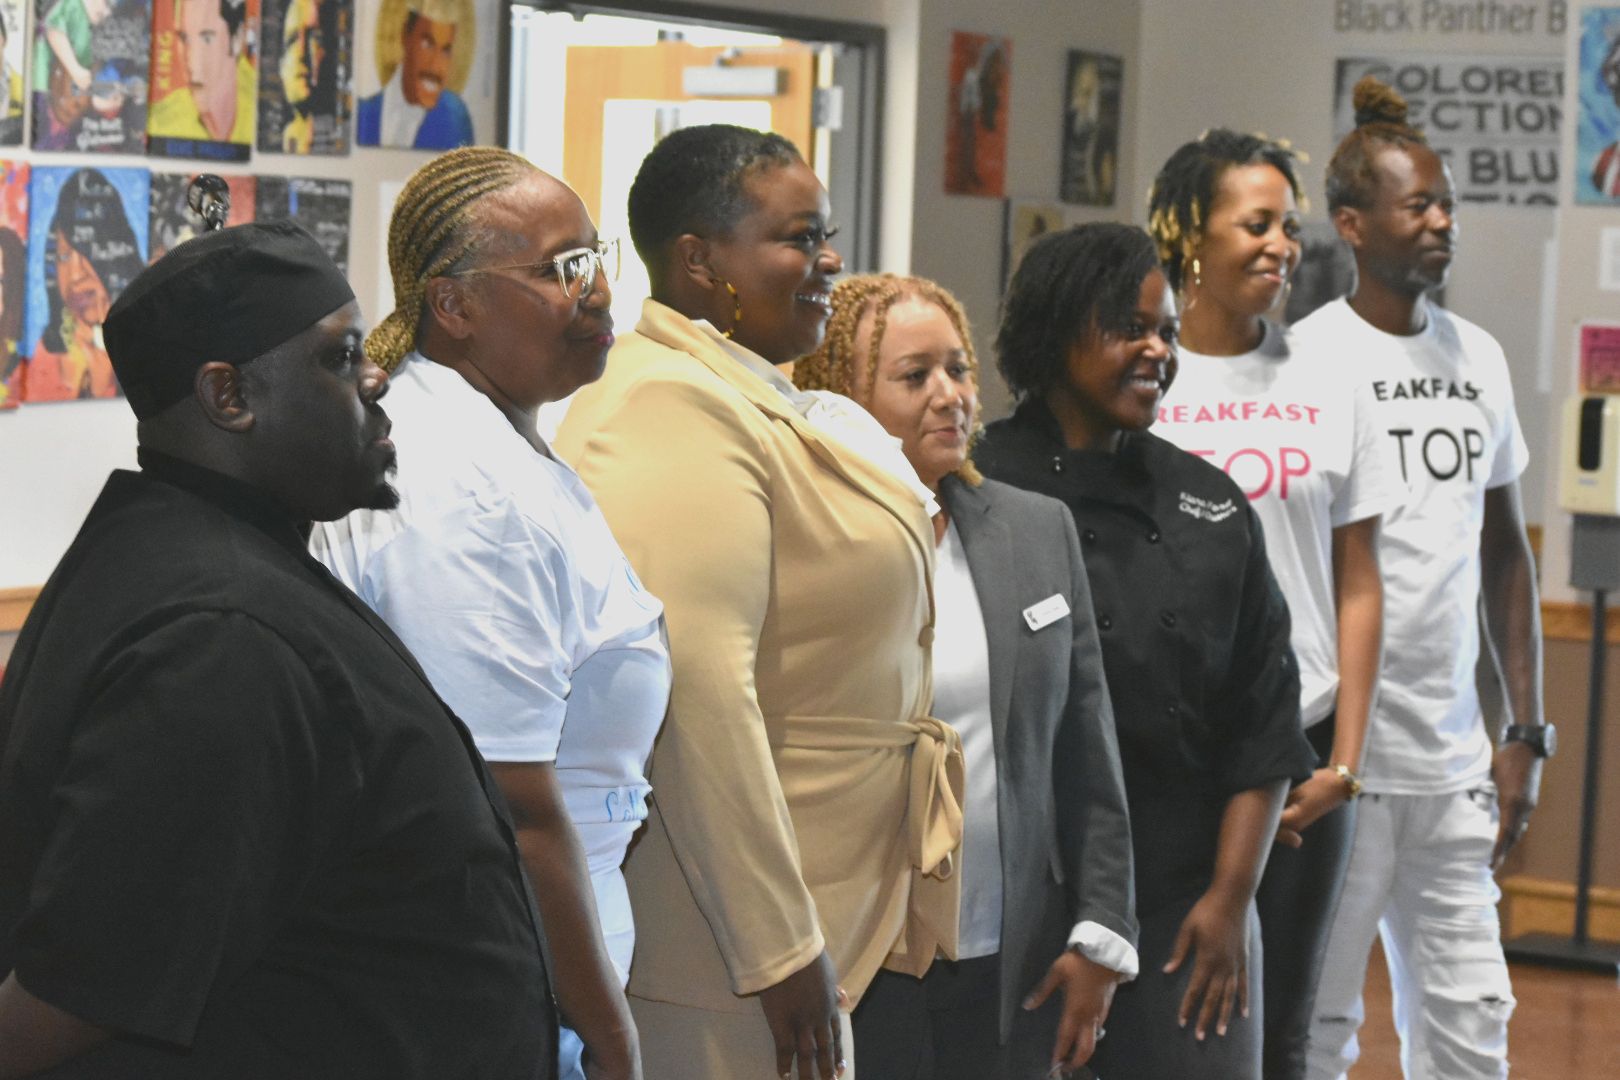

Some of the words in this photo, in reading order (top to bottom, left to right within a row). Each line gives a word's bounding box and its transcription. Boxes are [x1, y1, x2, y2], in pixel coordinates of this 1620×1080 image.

[1421, 0, 1536, 34] Panther
[1364, 64, 1564, 97] OLORE
[1372, 378, 1483, 402] EAKFAS
[1157, 401, 1321, 425] REAKFAST
